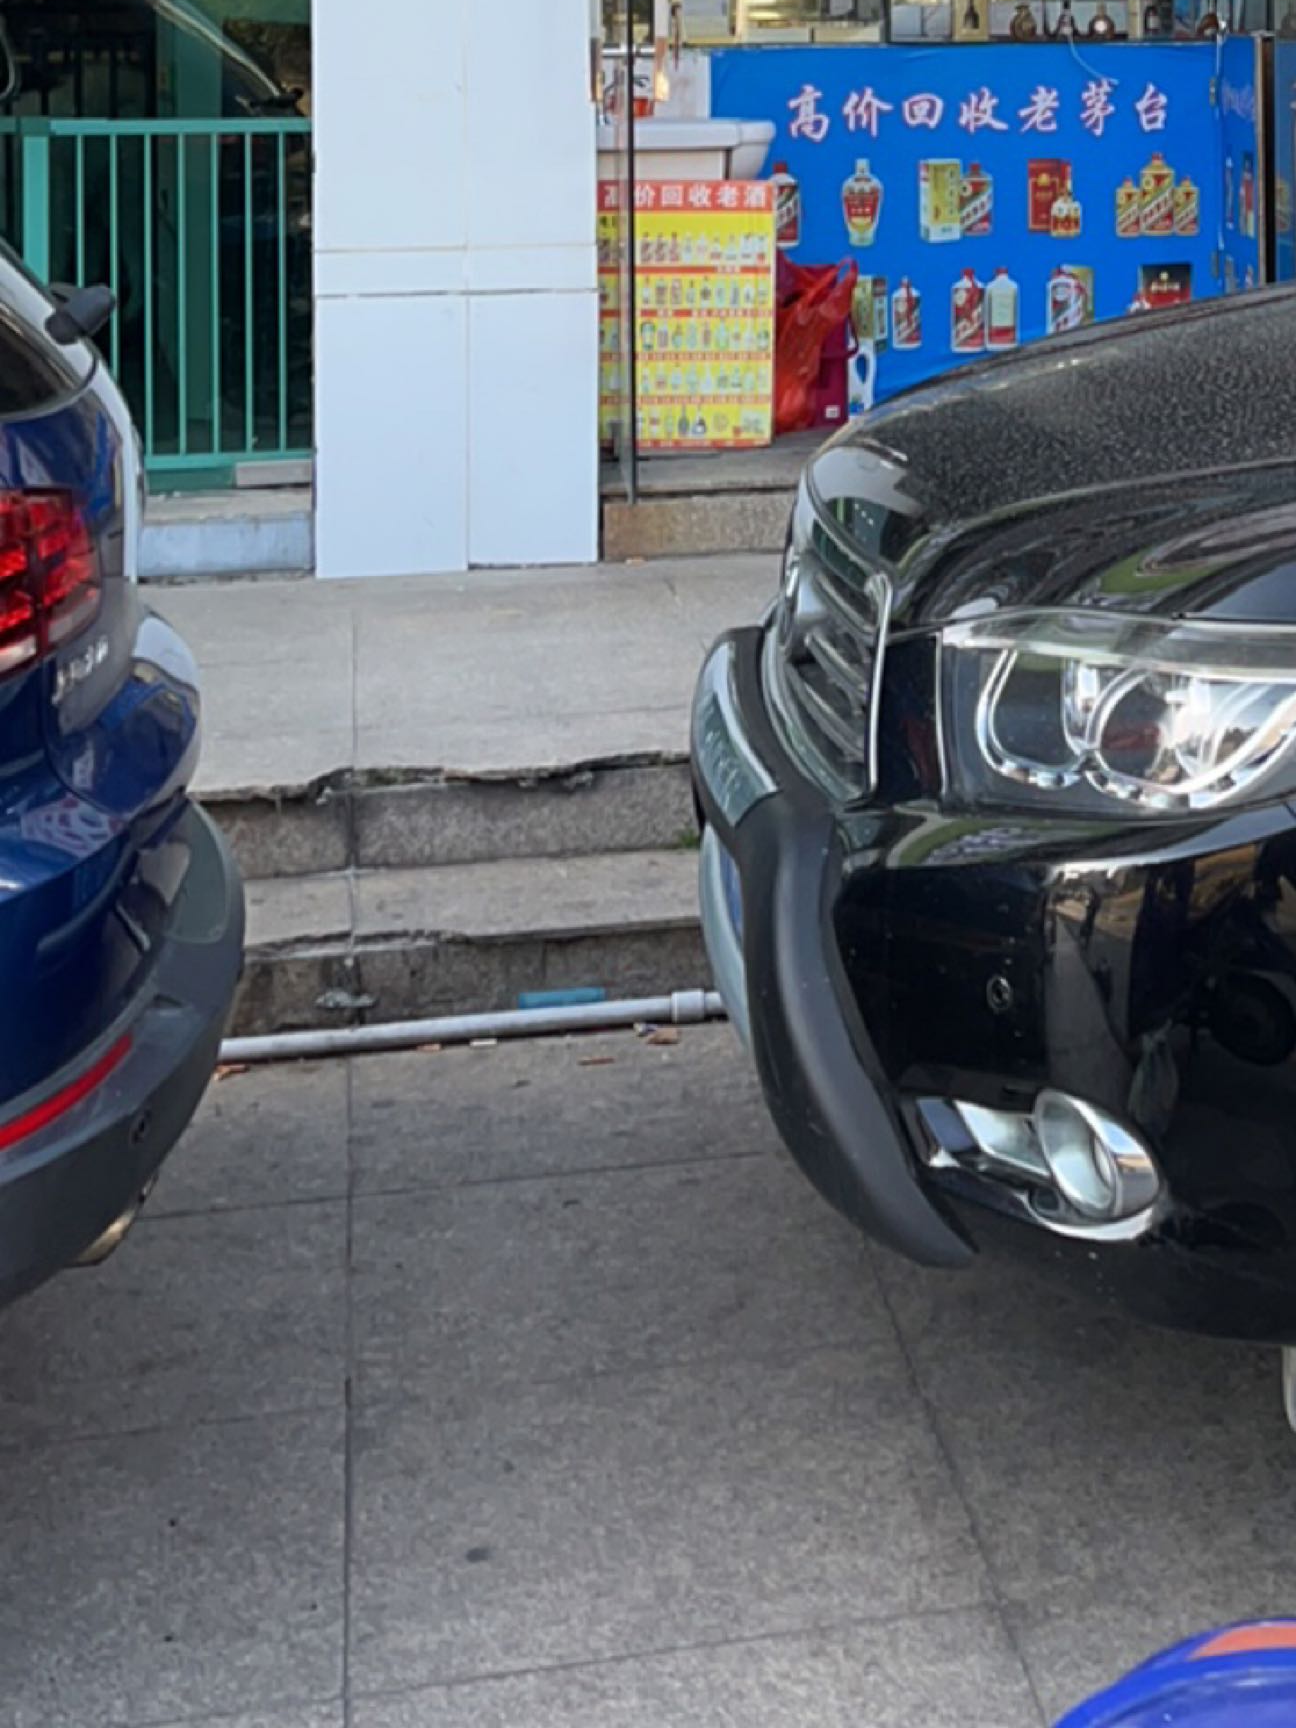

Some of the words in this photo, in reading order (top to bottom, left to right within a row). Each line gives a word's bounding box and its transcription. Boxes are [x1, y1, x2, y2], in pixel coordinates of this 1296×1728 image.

[788, 80, 1168, 141] 高价回收老茅台
